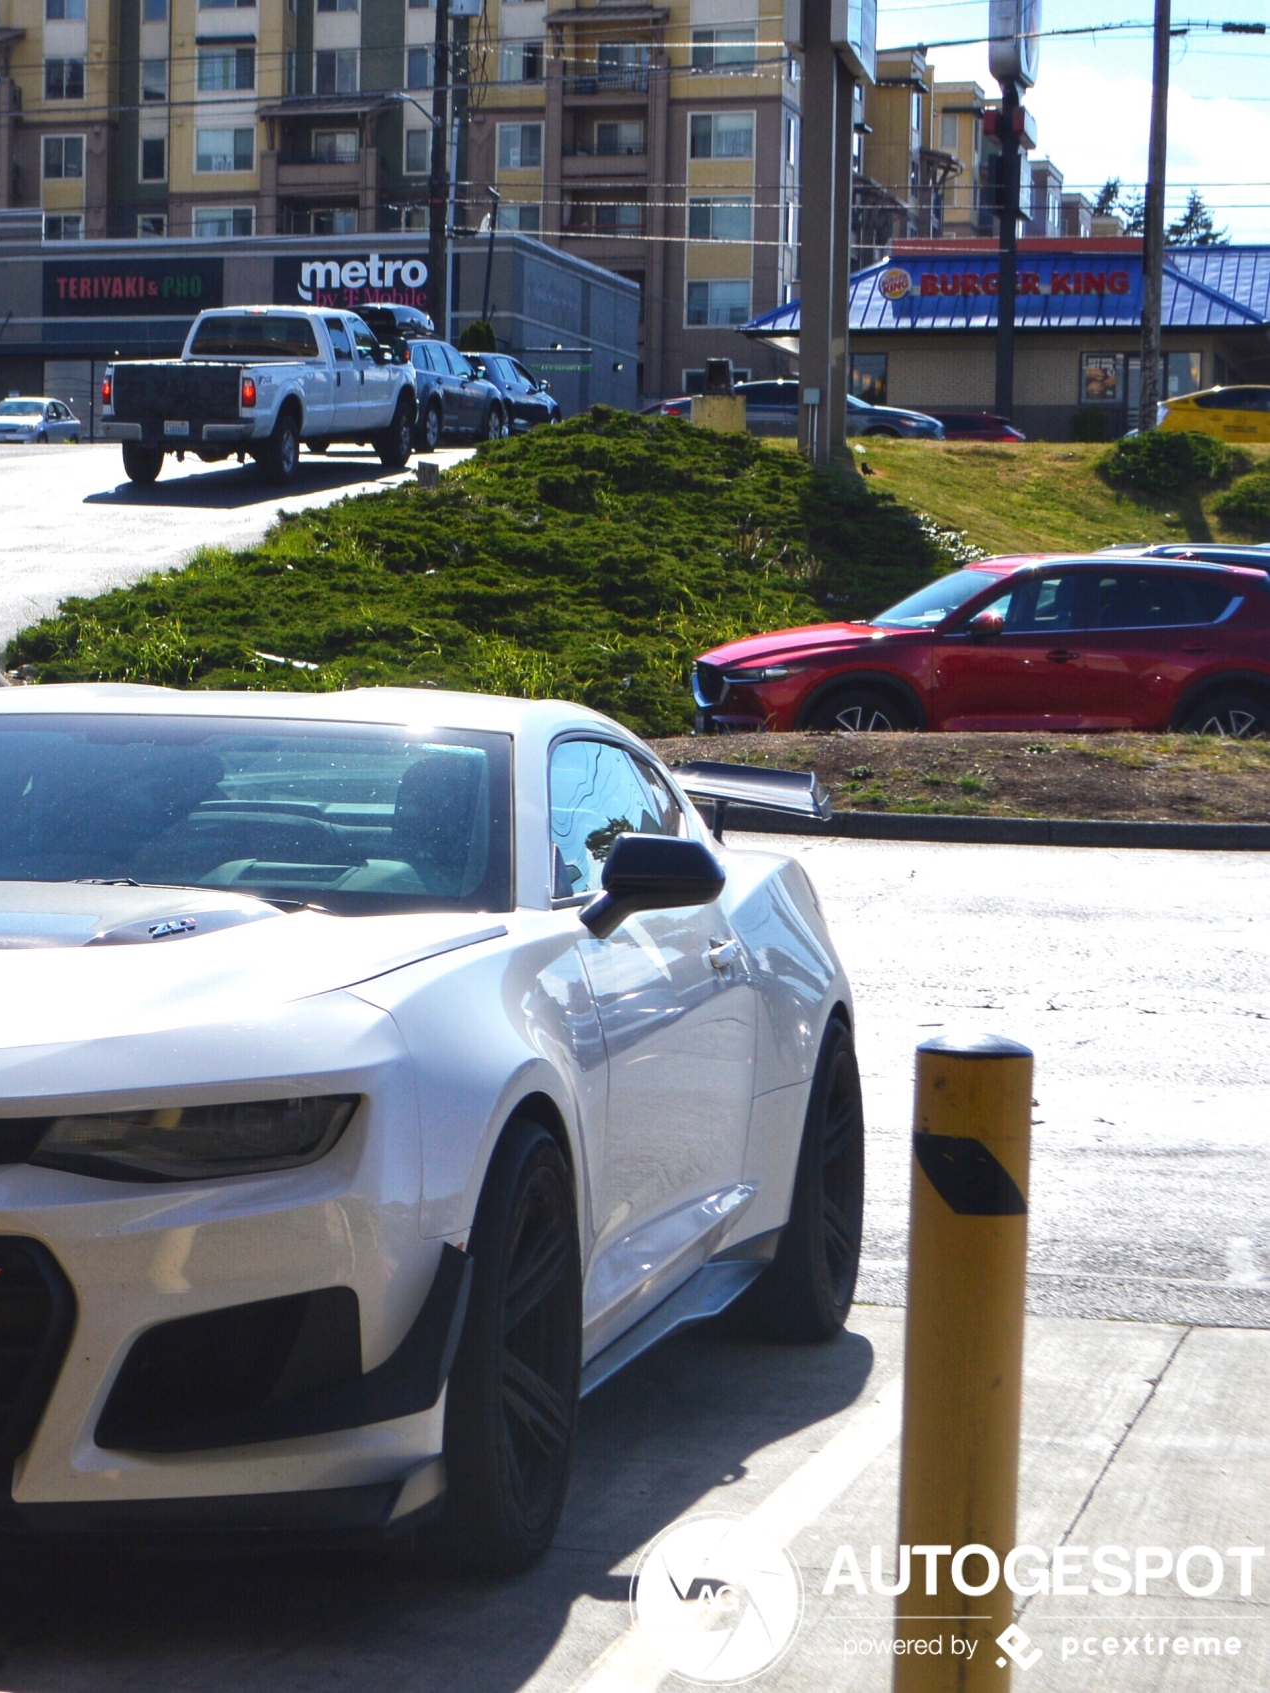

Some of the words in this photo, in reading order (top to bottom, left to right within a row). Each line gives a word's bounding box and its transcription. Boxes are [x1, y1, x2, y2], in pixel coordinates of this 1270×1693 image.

[298, 253, 428, 289] metro
[1051, 270, 1130, 296] KING
[57, 276, 145, 299] TERIYAKI
[148, 280, 158, 296] &
[162, 275, 202, 298] PHO
[315, 287, 338, 308] by
[364, 286, 427, 307] Mobile
